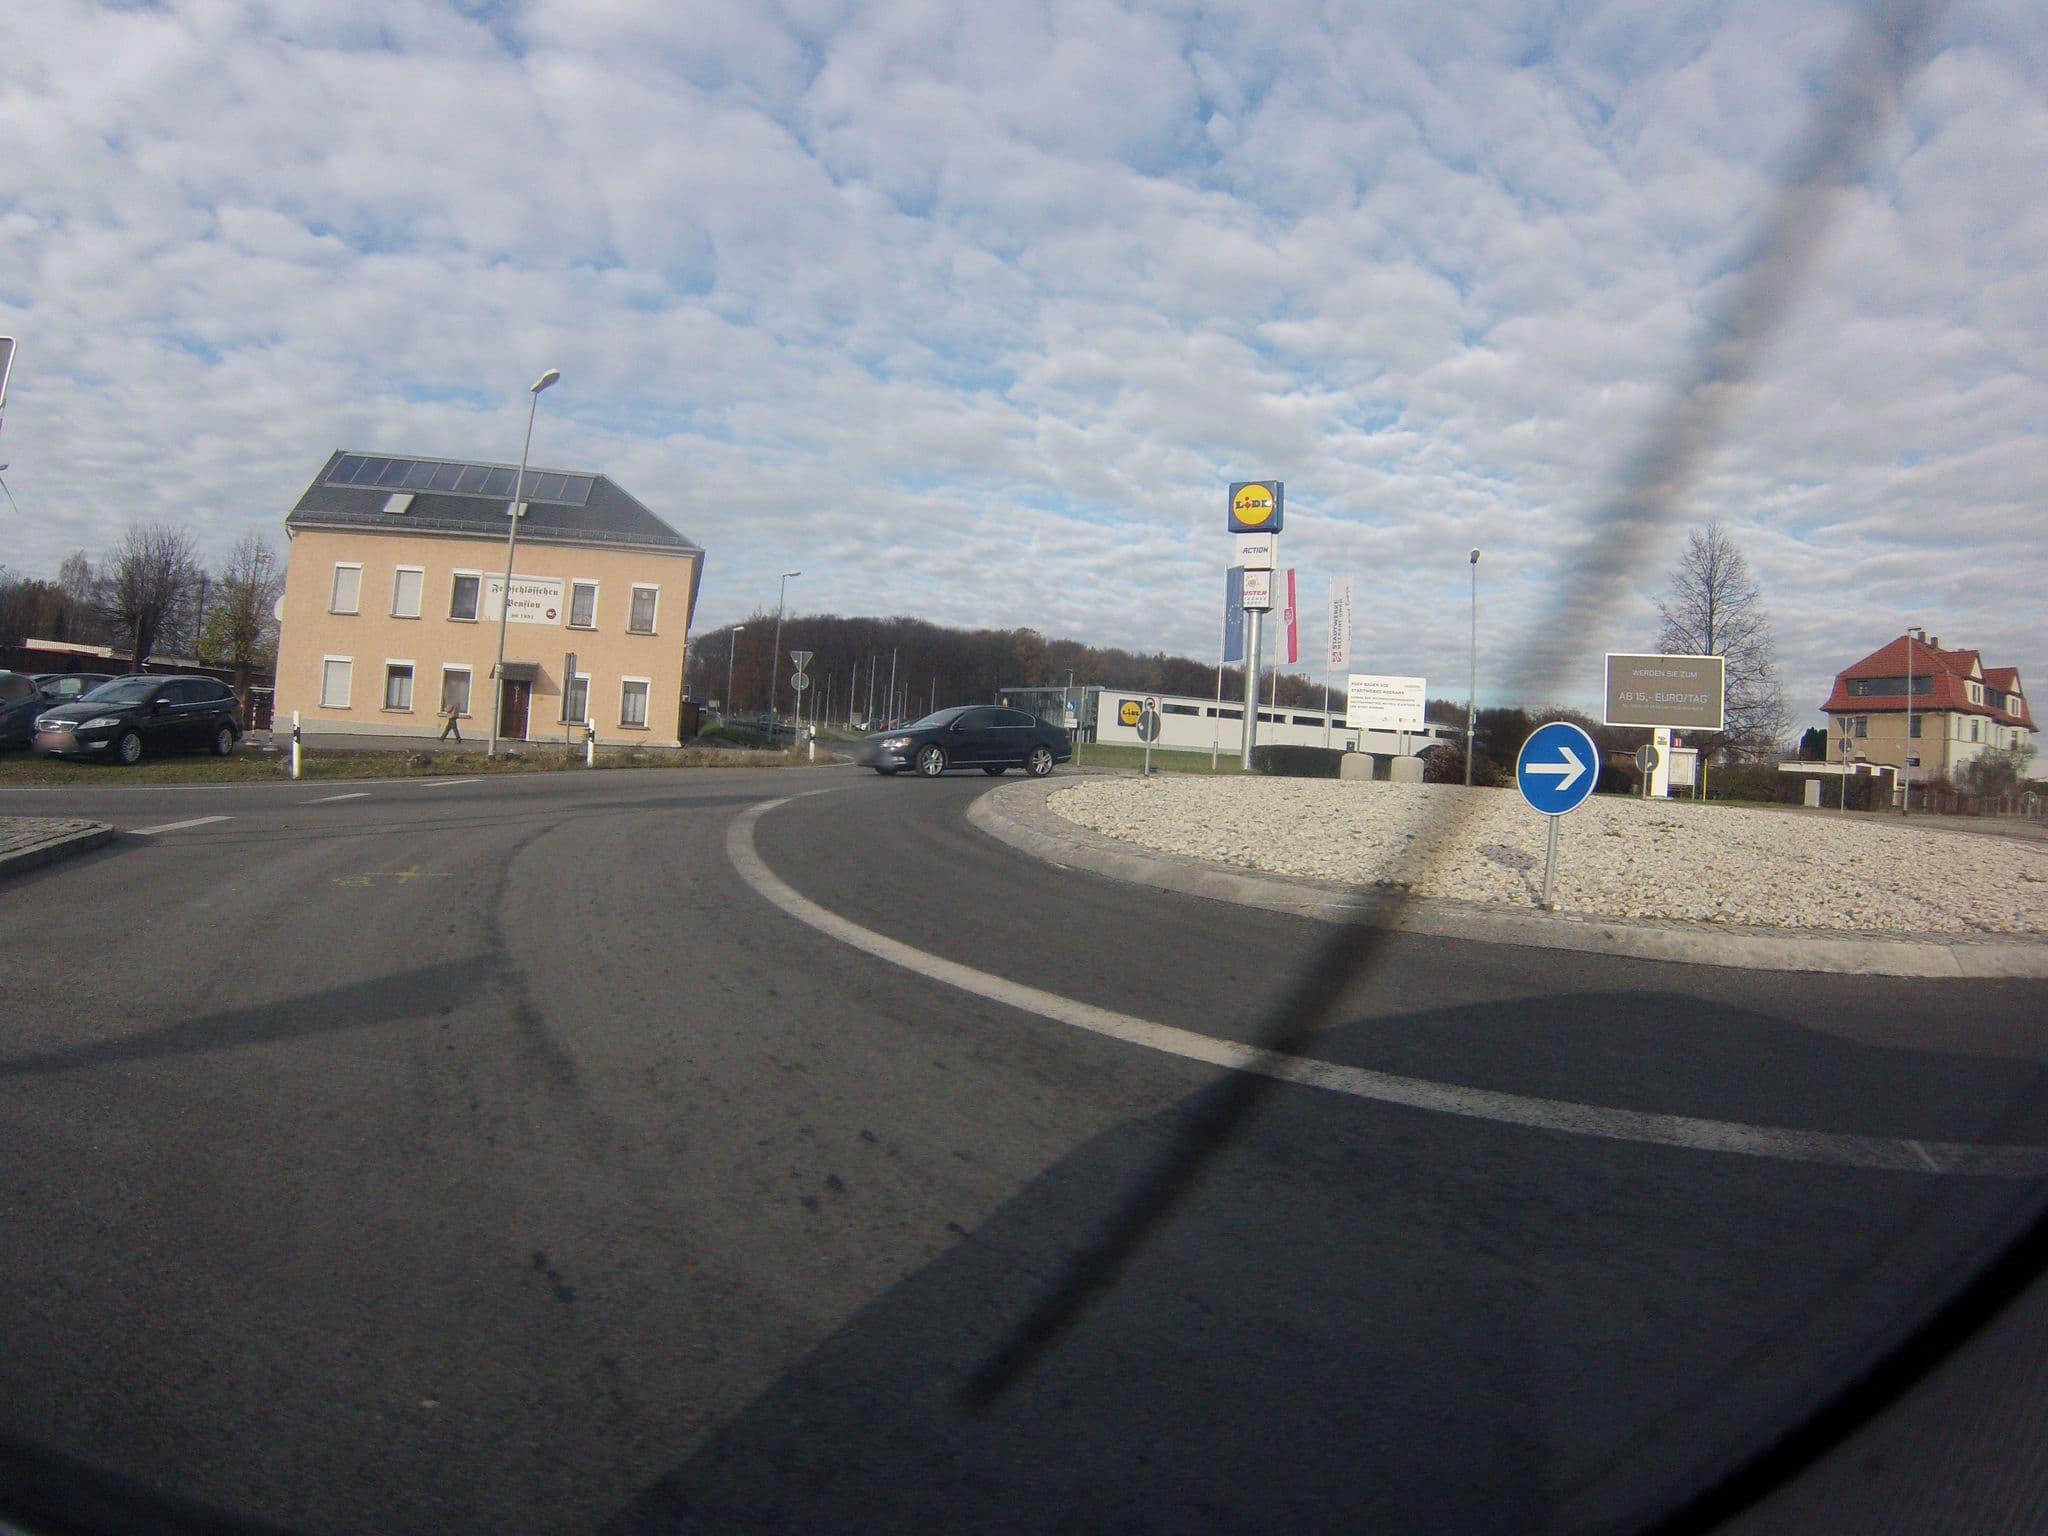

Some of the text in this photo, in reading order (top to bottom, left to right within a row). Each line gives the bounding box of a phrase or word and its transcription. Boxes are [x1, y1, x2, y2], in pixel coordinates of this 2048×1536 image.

[1242, 546, 1268, 555] ACTION
[1632, 669, 1698, 679] WERDEN SIE ZUM
[1619, 691, 1633, 701] AB
[1655, 692, 1709, 704] EURO/TAG
